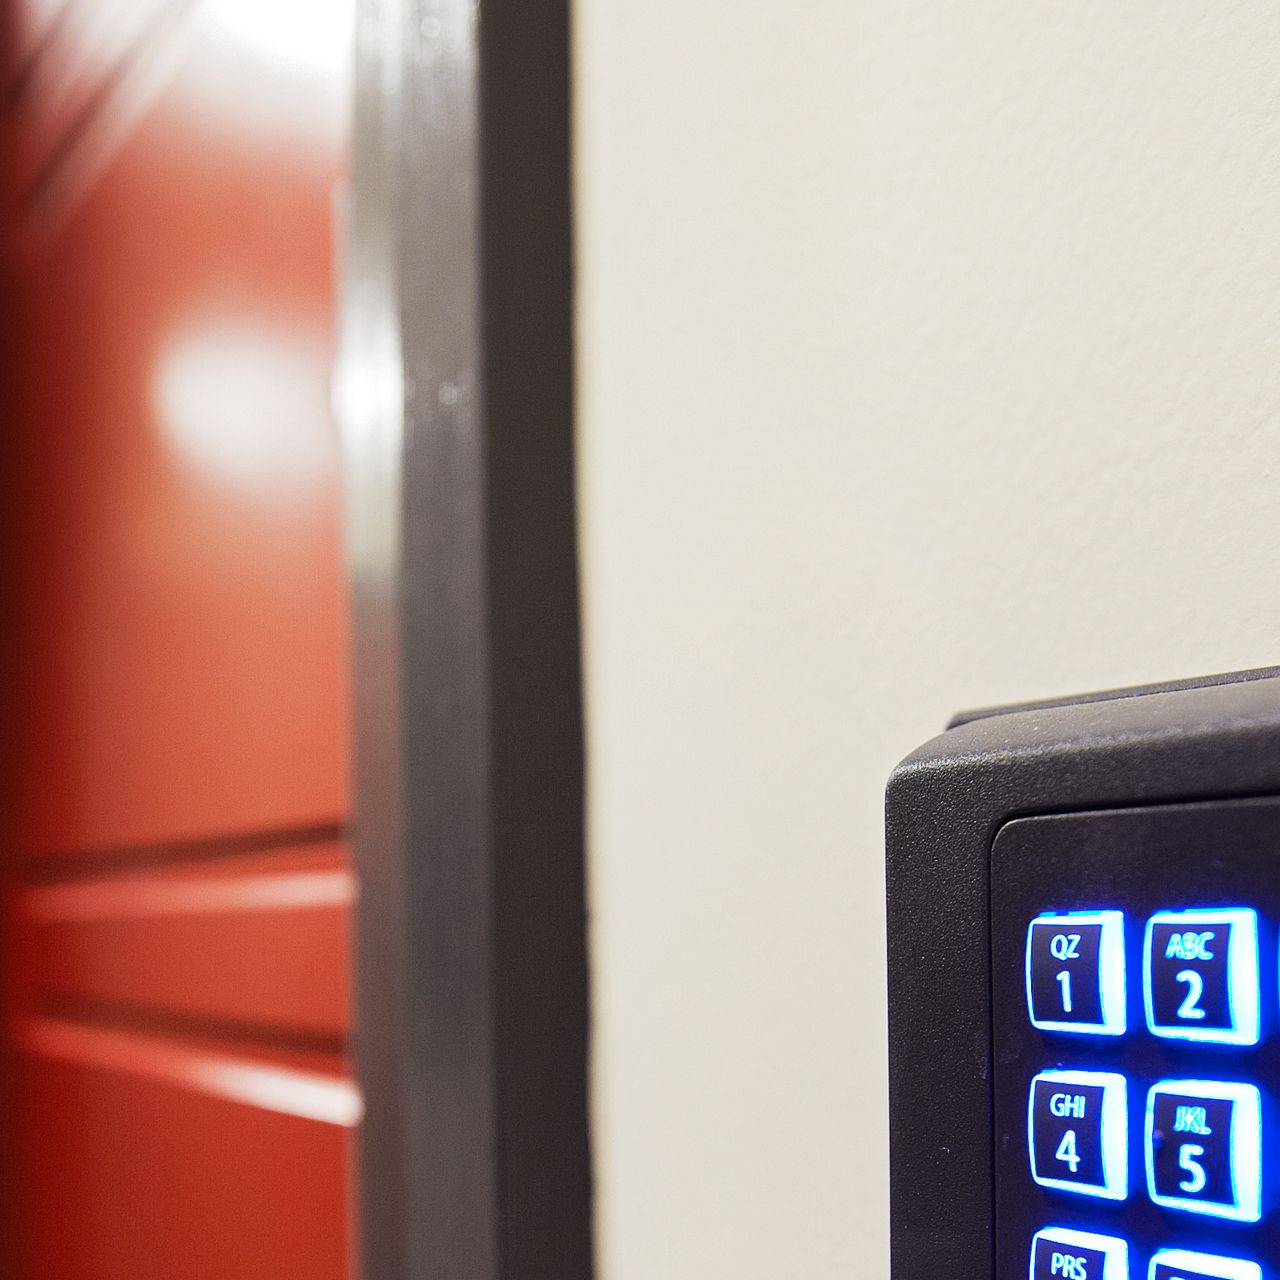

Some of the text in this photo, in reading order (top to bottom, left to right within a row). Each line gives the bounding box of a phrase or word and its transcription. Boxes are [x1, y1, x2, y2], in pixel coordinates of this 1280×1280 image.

[1050, 934, 1082, 961] QZ
[1164, 931, 1216, 961] ABC
[1055, 970, 1072, 1013] 1
[1175, 969, 1206, 1020] 2
[1049, 1092, 1087, 1119] GHI
[1173, 1105, 1213, 1136] JKL
[1055, 1129, 1081, 1173] 4
[1178, 1143, 1207, 1193] 5
